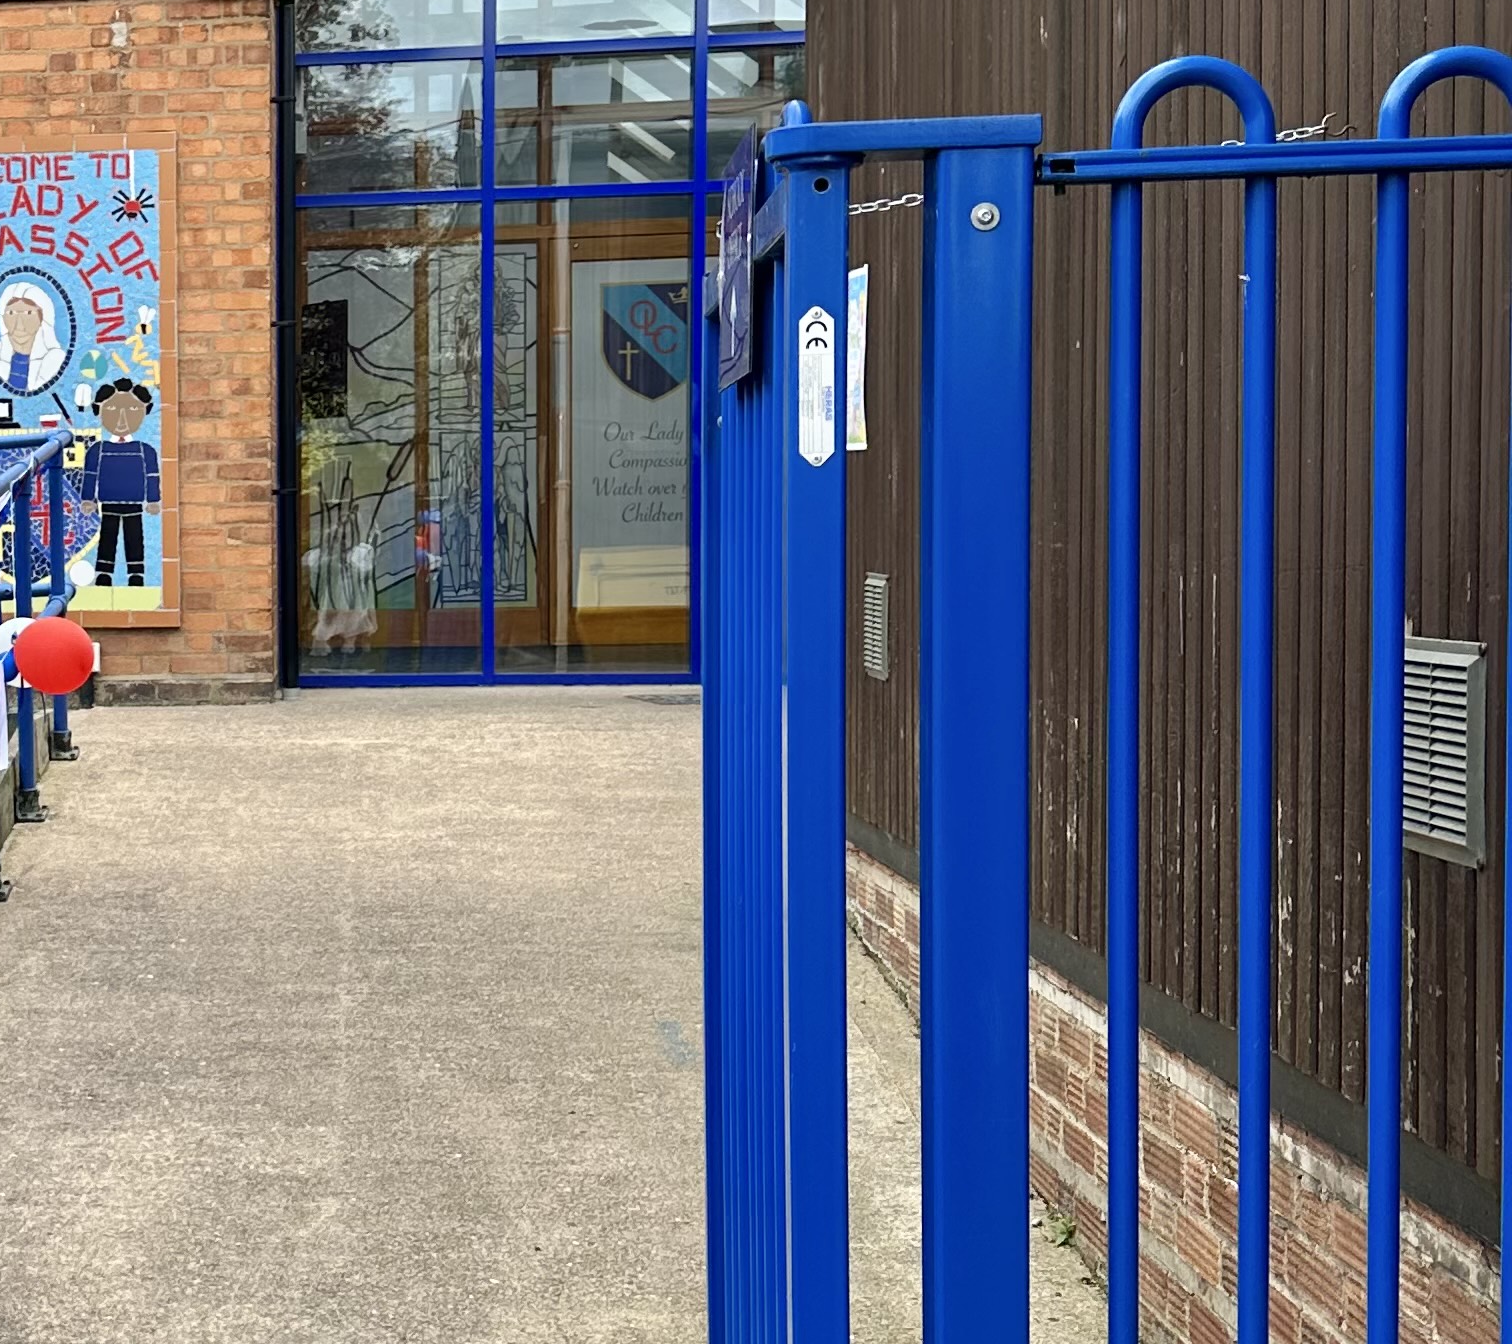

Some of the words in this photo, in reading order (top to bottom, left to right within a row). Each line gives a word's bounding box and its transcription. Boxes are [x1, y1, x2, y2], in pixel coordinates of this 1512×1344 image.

[89, 153, 131, 180] TO
[109, 231, 159, 282] OF
[824, 385, 833, 421] HERAS
[603, 421, 635, 442] Our
[641, 419, 684, 443] Lady
[609, 449, 687, 472] Compassio
[592, 475, 643, 497] Watch
[648, 483, 677, 495] over
[621, 502, 684, 523] Children
